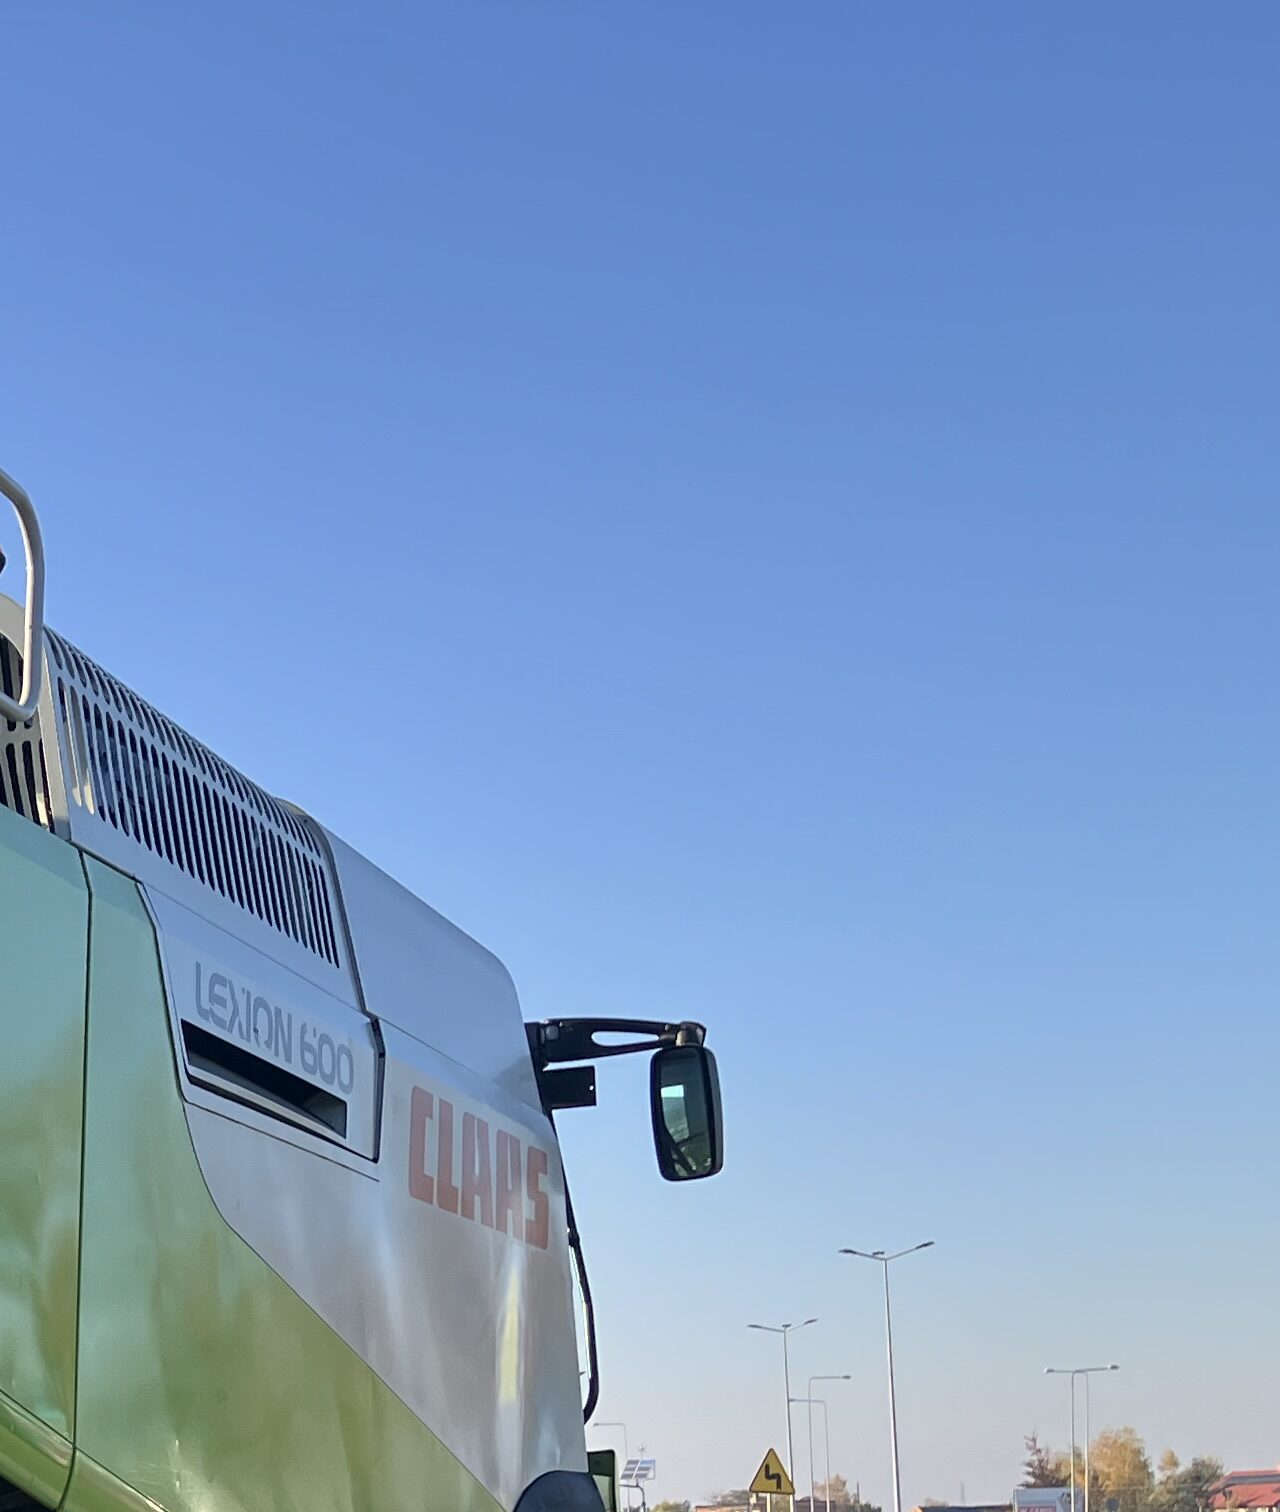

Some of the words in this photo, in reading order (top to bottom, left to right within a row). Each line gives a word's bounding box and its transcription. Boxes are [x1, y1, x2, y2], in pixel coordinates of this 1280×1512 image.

[193, 960, 293, 1065] LEXION
[300, 1021, 355, 1096] 600
[408, 1085, 550, 1250] CLAAS
